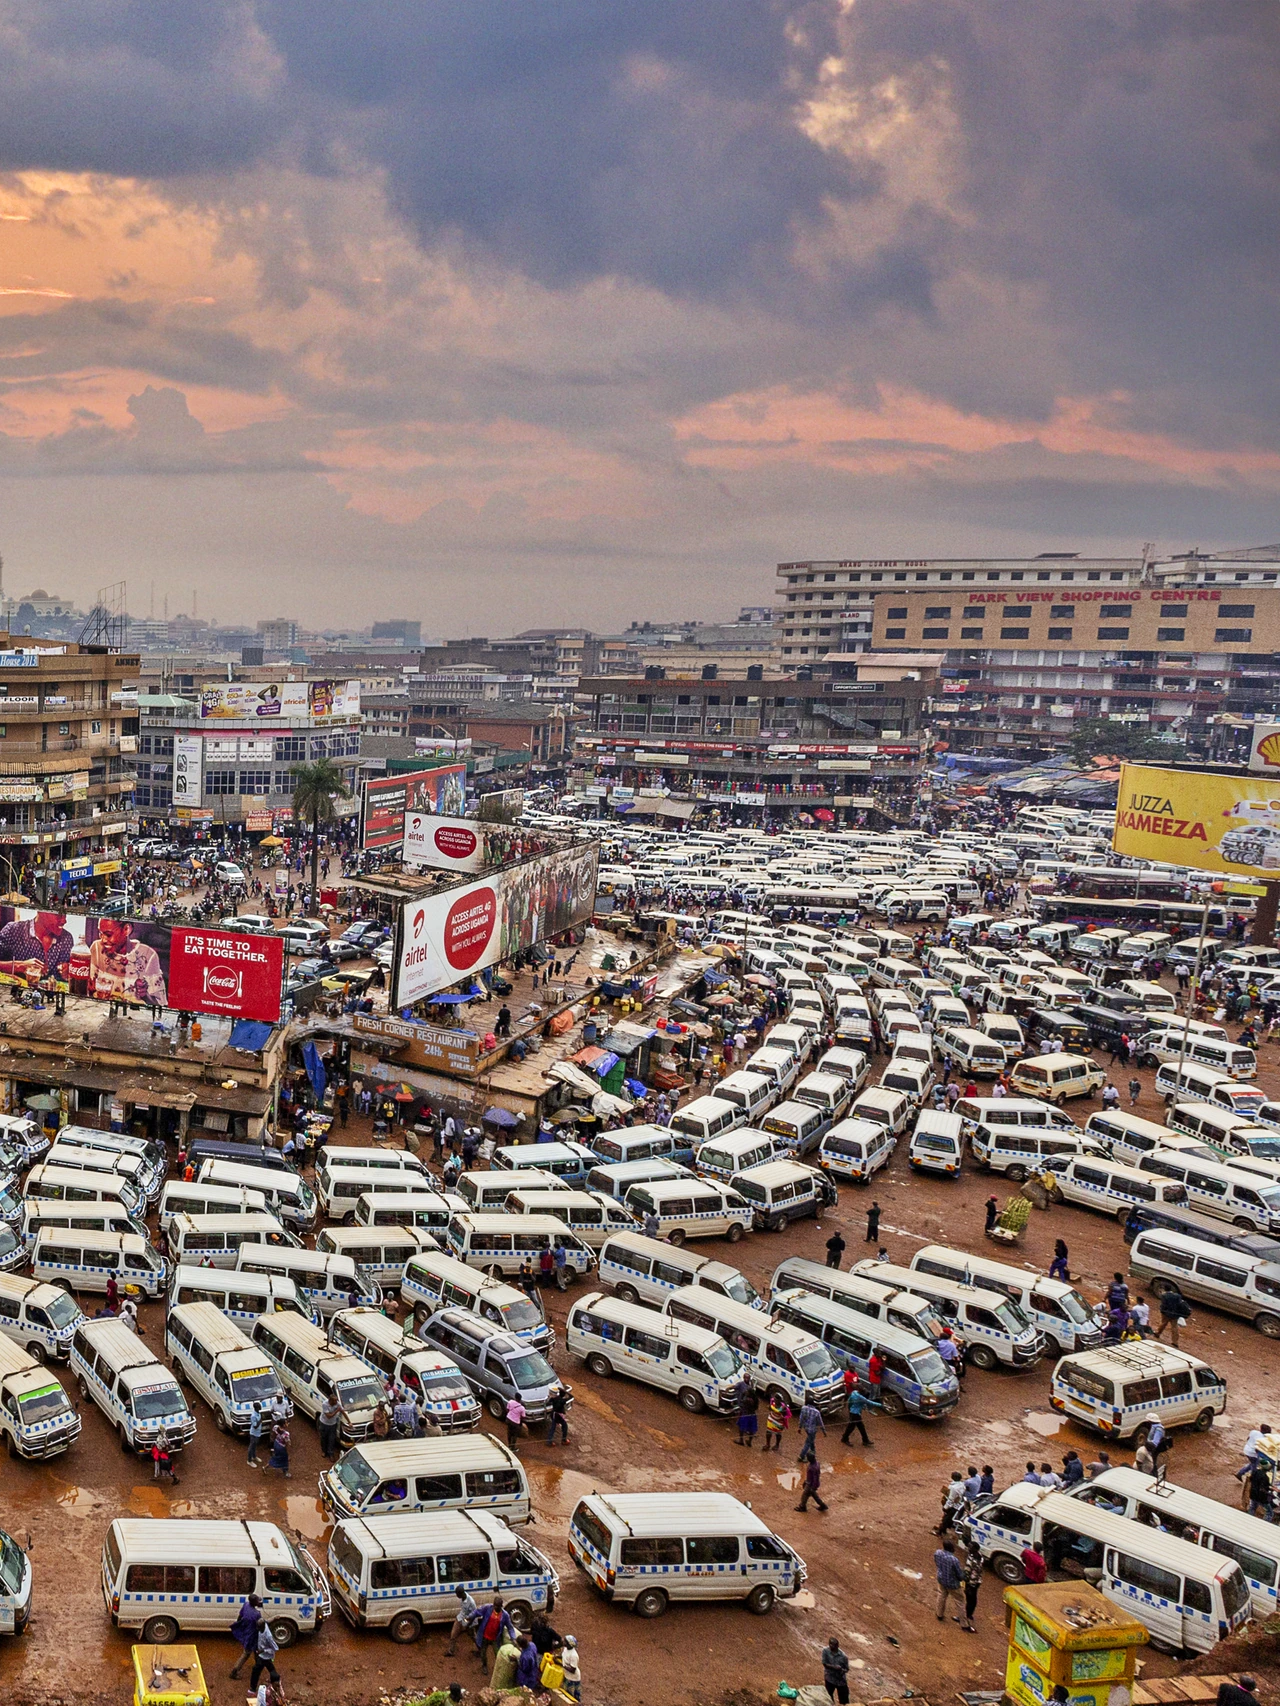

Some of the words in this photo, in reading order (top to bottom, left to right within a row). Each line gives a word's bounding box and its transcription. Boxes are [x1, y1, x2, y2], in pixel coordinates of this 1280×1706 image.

[969, 593, 1007, 603] PARK
[1016, 592, 1054, 602] VIEW
[1060, 590, 1142, 602] SHOPPING
[1150, 590, 1221, 601] CENTRE
[0, 654, 21, 667] House
[21, 654, 38, 667] 2013
[1128, 793, 1174, 816] JUZZA
[407, 830, 425, 842] airtel
[68, 868, 88, 879] TECNO
[451, 910, 469, 926] ACCESS
[469, 906, 484, 920] AIRTEL
[484, 900, 492, 911] 4G
[451, 922, 470, 937] ACROSS
[470, 914, 489, 930] UGANDA
[184, 935, 204, 946] IT'S
[206, 937, 233, 950] TIME
[235, 941, 251, 951] TO
[451, 941, 463, 953] WITH
[184, 945, 205, 955] EAT
[206, 947, 269, 963] TOGETHER.
[404, 942, 428, 968] airtel
[223, 1002, 242, 1010] FEELING
[357, 1017, 382, 1031] FRESH
[384, 1023, 414, 1038] CORNER
[416, 1029, 468, 1050] RESTAURANT
